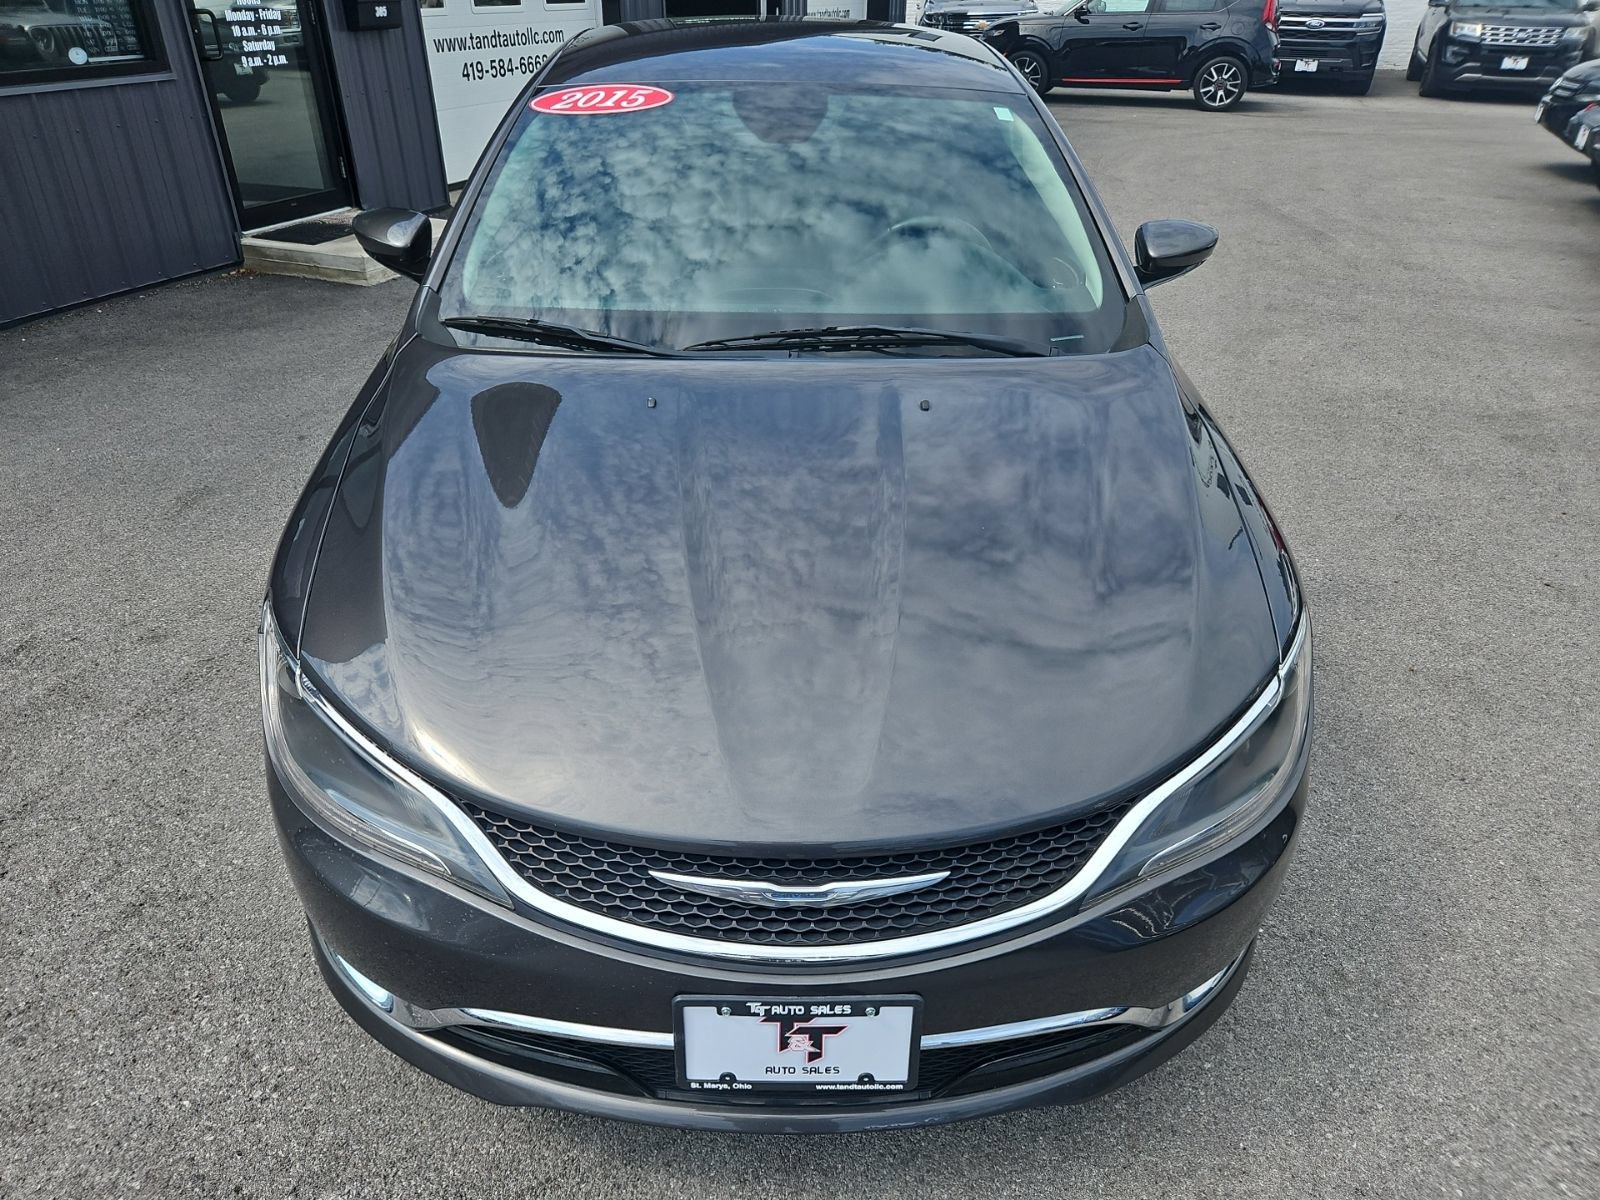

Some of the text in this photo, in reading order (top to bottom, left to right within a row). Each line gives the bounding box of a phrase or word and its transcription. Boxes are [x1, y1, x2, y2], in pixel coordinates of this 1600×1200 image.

[224, 9, 255, 22] Monday
[258, 8, 282, 21] Friday
[231, 24, 242, 37] 10
[241, 26, 258, 37] a.m.
[260, 23, 268, 36] 6
[242, 39, 276, 52] Saturday
[433, 27, 565, 53] www.tandtautollc.com
[241, 55, 248, 68] 9
[247, 56, 264, 67] a.m.
[266, 54, 273, 66] 2
[272, 54, 289, 66] p.m.
[549, 89, 654, 110] 2015
[771, 1004, 805, 1016] AUTO
[810, 1004, 852, 1016] SALES
[765, 1066, 840, 1075] AUTO SALES
[703, 1082, 731, 1090] Marys,
